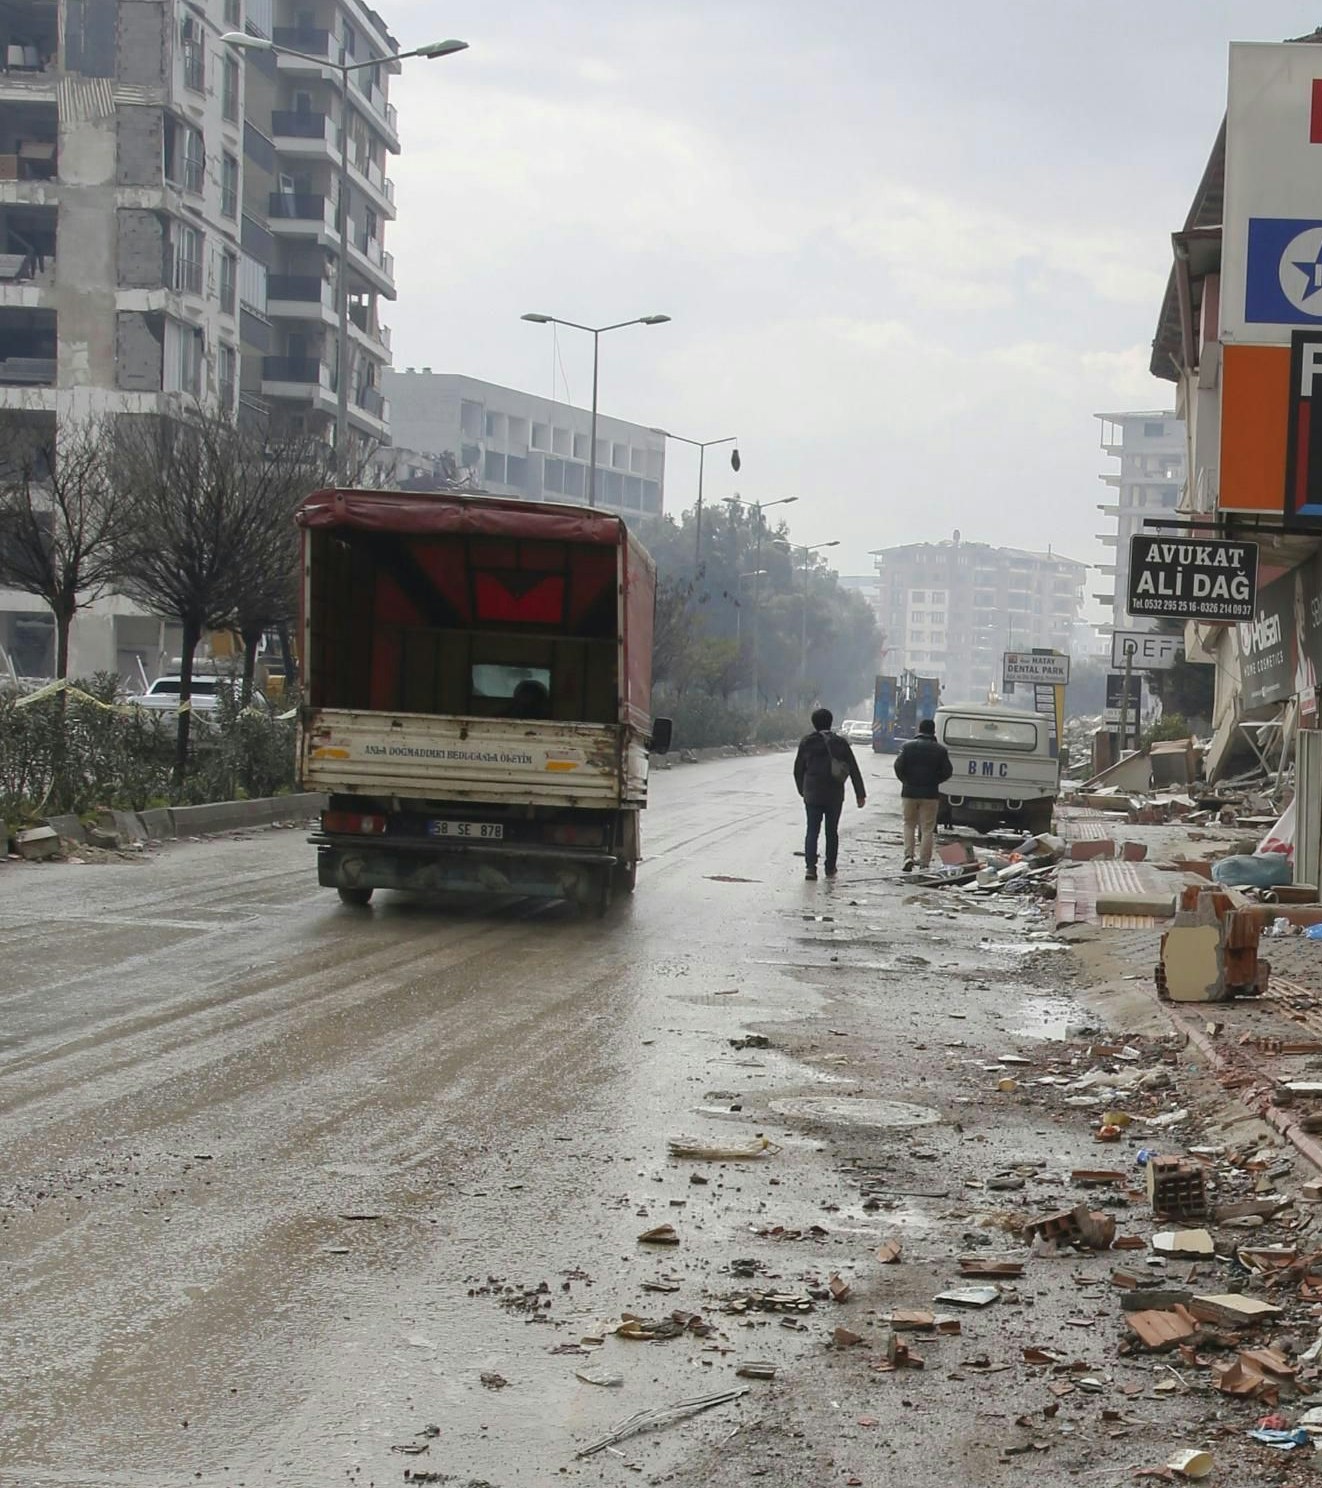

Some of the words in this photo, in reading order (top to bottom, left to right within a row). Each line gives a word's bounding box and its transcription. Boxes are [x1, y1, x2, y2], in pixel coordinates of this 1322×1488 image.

[1145, 543, 1244, 568] AVUKAT
[1136, 567, 1183, 596] ALİ
[1193, 570, 1250, 600] DAĞ
[1163, 600, 1177, 611] 295
[1178, 601, 1188, 611] 25
[1220, 603, 1232, 614] 214
[1007, 665, 1039, 674] DENTAL
[1042, 666, 1064, 675] PARK
[458, 823, 472, 836] SE
